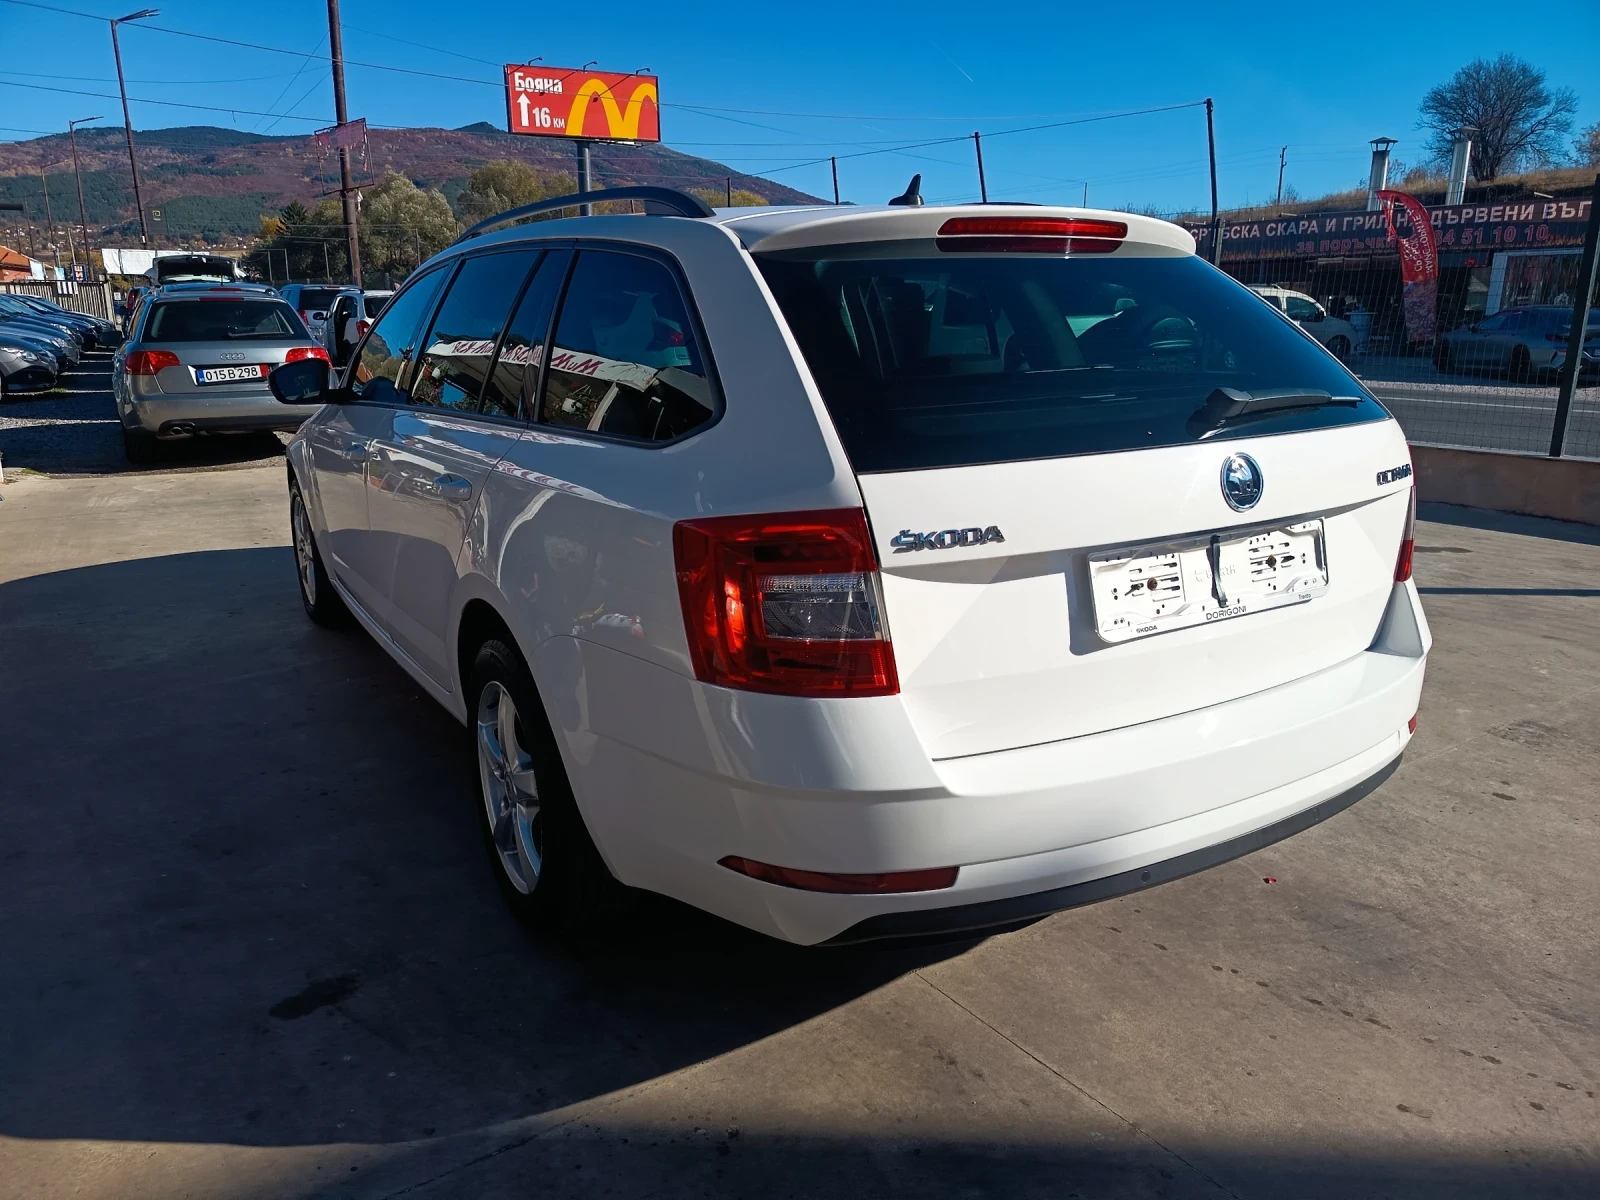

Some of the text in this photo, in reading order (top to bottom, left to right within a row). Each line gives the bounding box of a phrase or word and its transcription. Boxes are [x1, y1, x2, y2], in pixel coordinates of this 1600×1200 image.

[514, 72, 563, 94] Бояна
[532, 107, 552, 128] 16
[1190, 223, 1260, 241] СРБСКА
[1266, 219, 1319, 237] СКАРА
[1325, 218, 1337, 233] И
[1430, 204, 1535, 228] ДЪРВЕНИ
[1296, 241, 1314, 254] за
[1461, 227, 1484, 245] 51
[1493, 226, 1517, 244] 10
[1525, 224, 1549, 242] 10
[1205, 605, 1247, 620] DORIGONI
